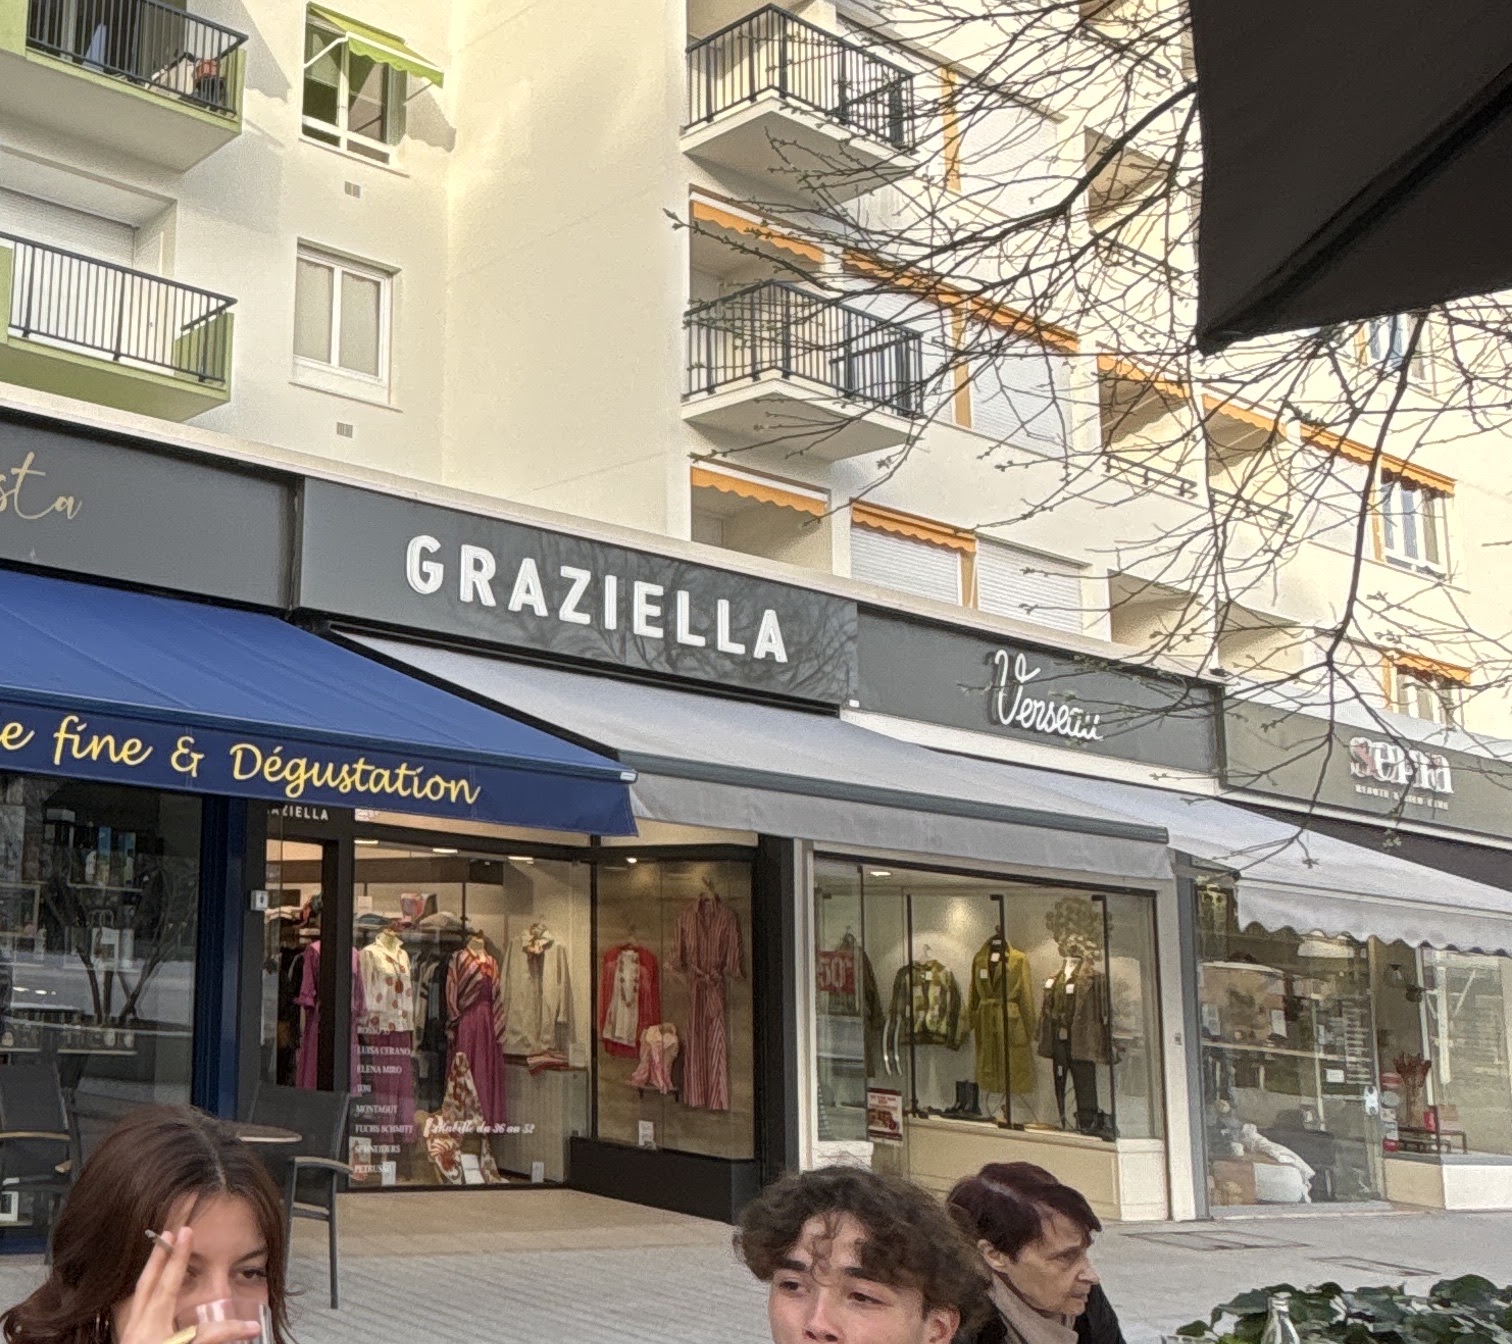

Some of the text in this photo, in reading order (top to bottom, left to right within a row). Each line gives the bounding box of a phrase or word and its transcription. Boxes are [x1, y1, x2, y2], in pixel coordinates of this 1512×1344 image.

[405, 534, 789, 663] GRAZIELLA
[52, 715, 153, 766] fine
[169, 735, 205, 777] &
[228, 742, 482, 805] Dégustation
